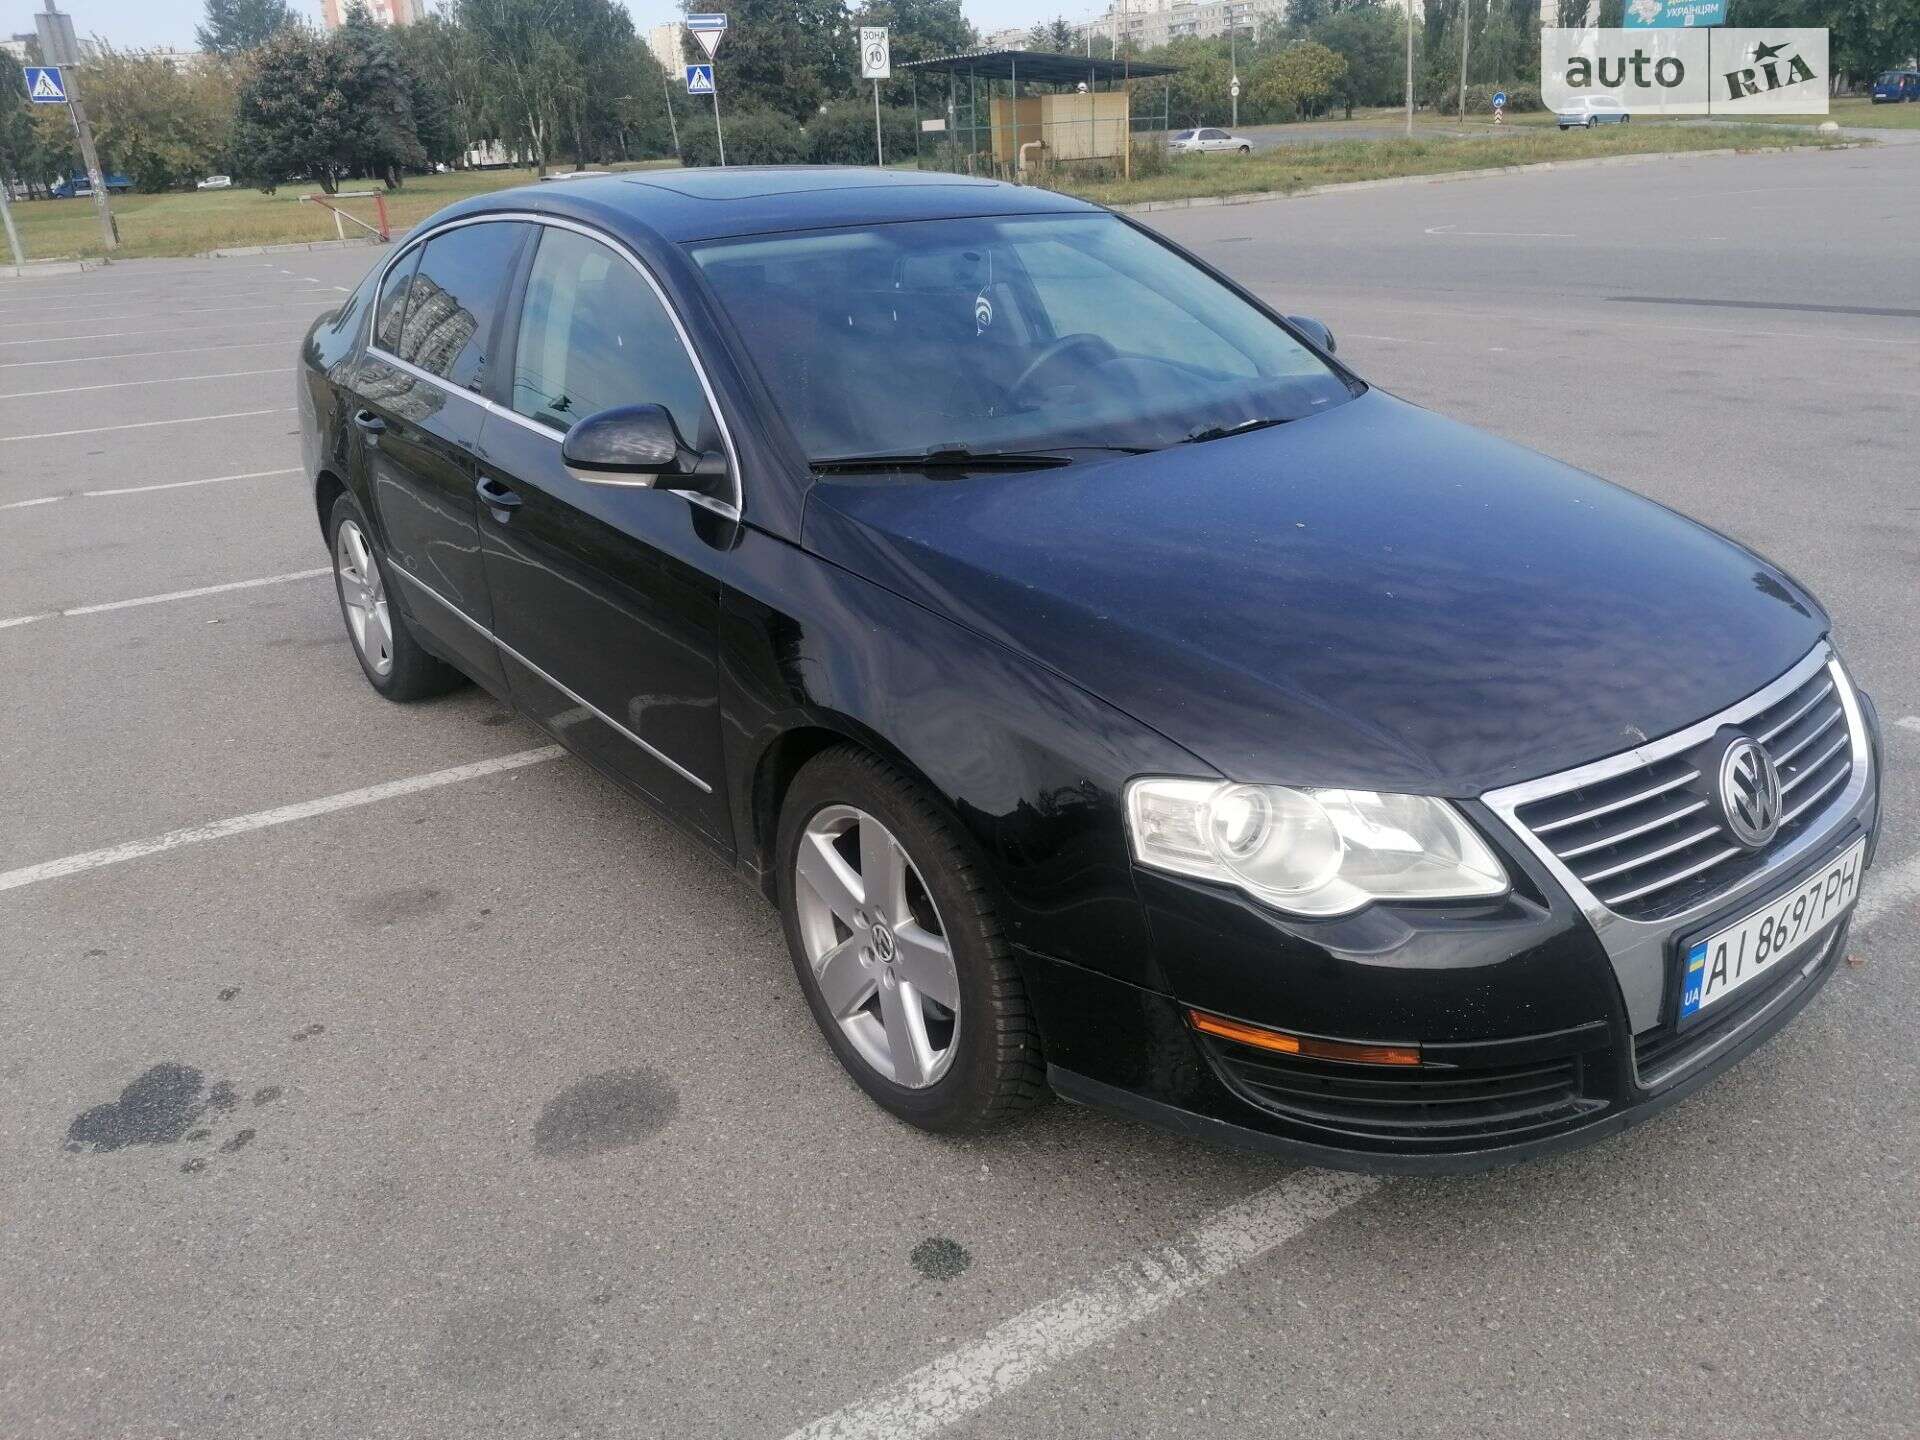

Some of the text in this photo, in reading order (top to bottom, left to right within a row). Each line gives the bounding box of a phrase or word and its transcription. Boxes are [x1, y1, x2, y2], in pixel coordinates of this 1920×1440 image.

[864, 31, 885, 40] ЗОНА
[870, 51, 882, 62] 10
[1685, 987, 1699, 1006] UA
